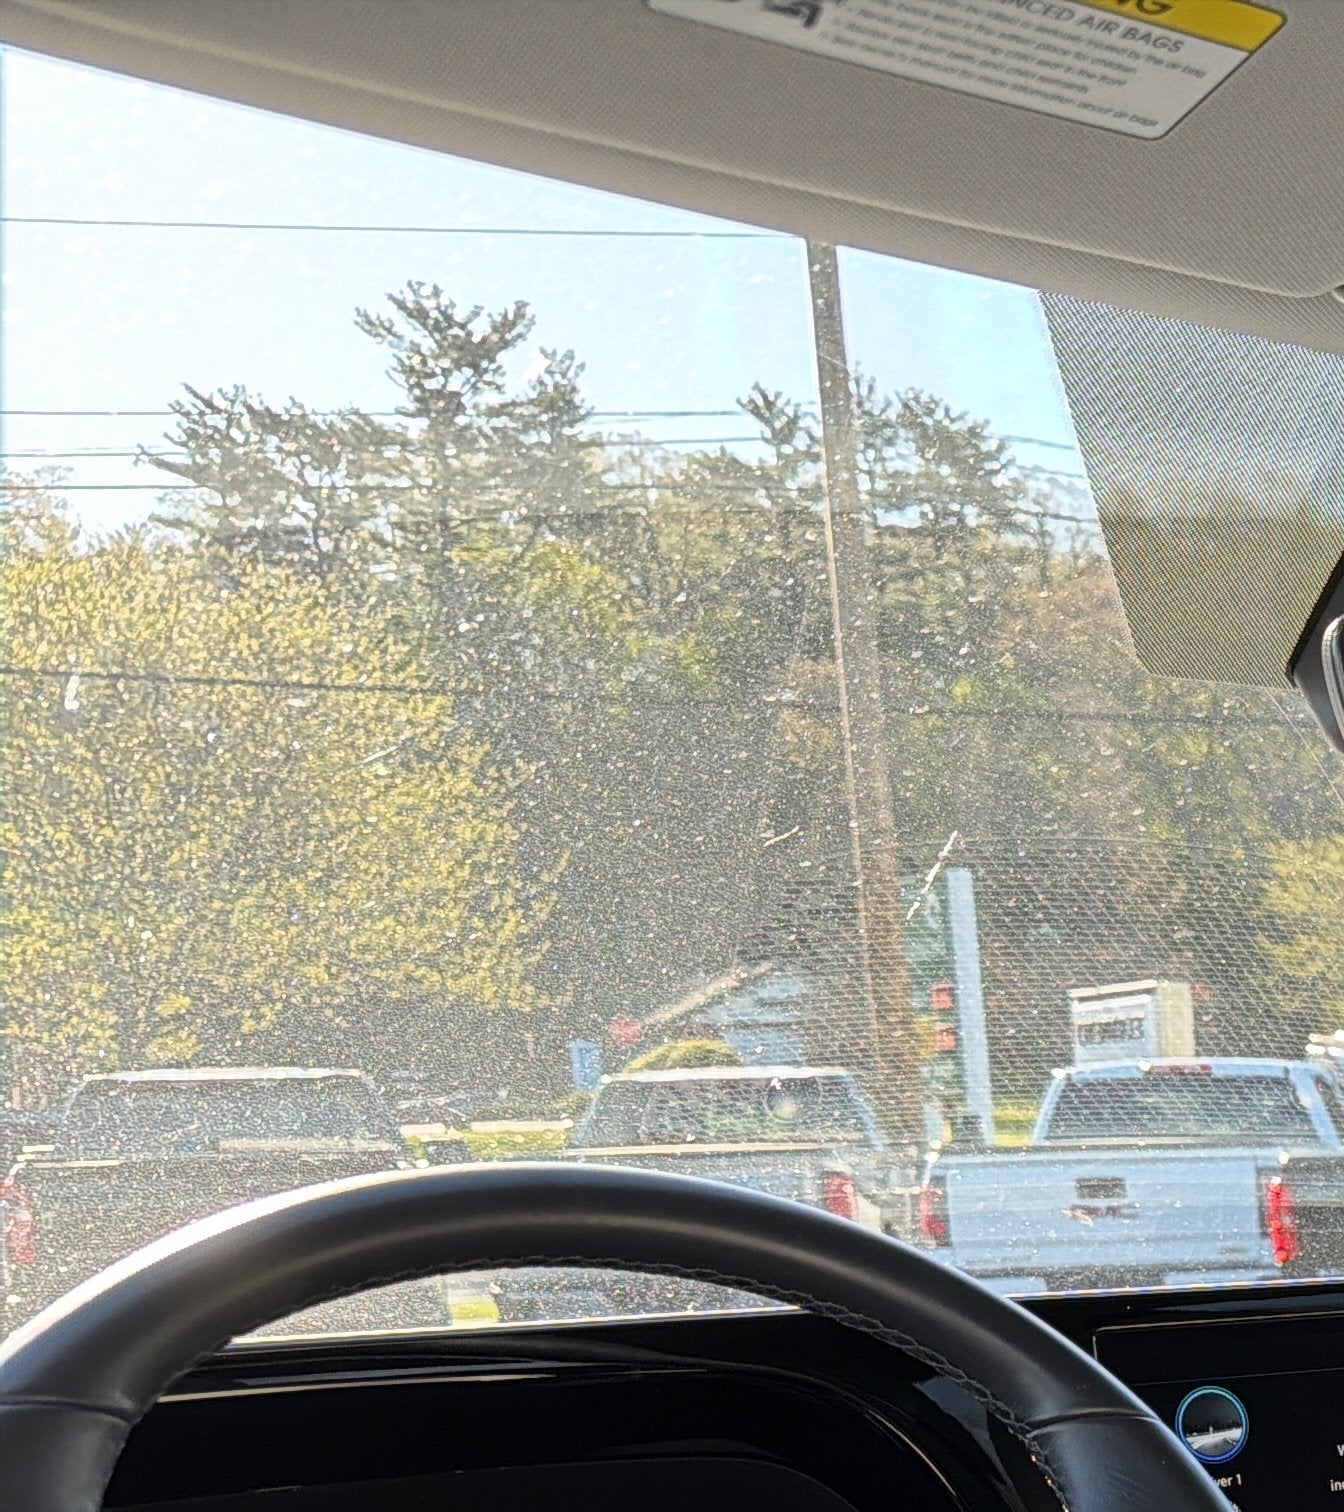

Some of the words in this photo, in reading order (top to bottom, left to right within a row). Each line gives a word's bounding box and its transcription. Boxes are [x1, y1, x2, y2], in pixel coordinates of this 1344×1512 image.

[1078, 15, 1119, 35] AIR
[1121, 27, 1184, 52] BAGS
[1235, 1473, 1242, 1486] 1
